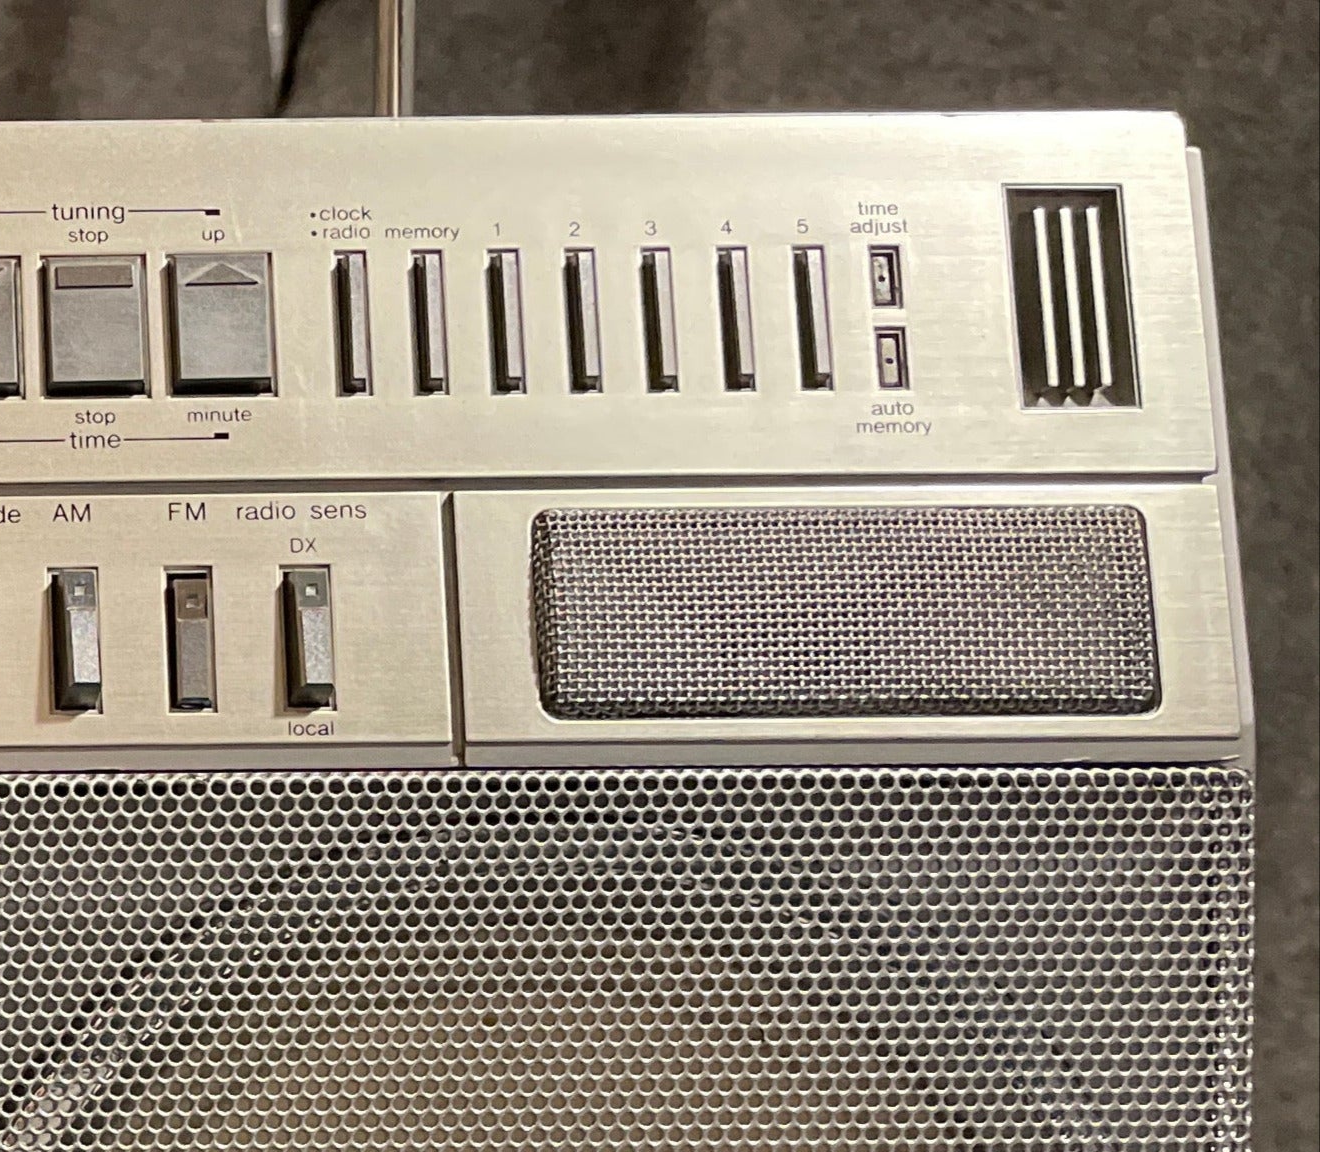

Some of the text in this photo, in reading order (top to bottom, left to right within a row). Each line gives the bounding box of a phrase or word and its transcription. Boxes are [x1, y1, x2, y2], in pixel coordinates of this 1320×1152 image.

[52, 204, 124, 224] tuning
[320, 206, 371, 221] clock
[858, 202, 898, 215] time
[323, 224, 370, 239] radio
[385, 227, 459, 241] memory
[569, 222, 580, 237] 2
[645, 221, 657, 236] 3
[721, 221, 732, 234] 4
[797, 219, 809, 234] 5
[850, 219, 908, 236] adjust
[69, 228, 108, 244] stop
[202, 229, 225, 243] up
[188, 408, 252, 422] minute
[872, 401, 914, 415] auto
[75, 410, 115, 426] stop
[857, 421, 931, 435] memory
[70, 432, 121, 449] time
[53, 504, 90, 522] AM
[169, 502, 205, 520] FM
[237, 501, 366, 520] radio sens
[290, 538, 317, 553] DX
[289, 721, 334, 736] local
